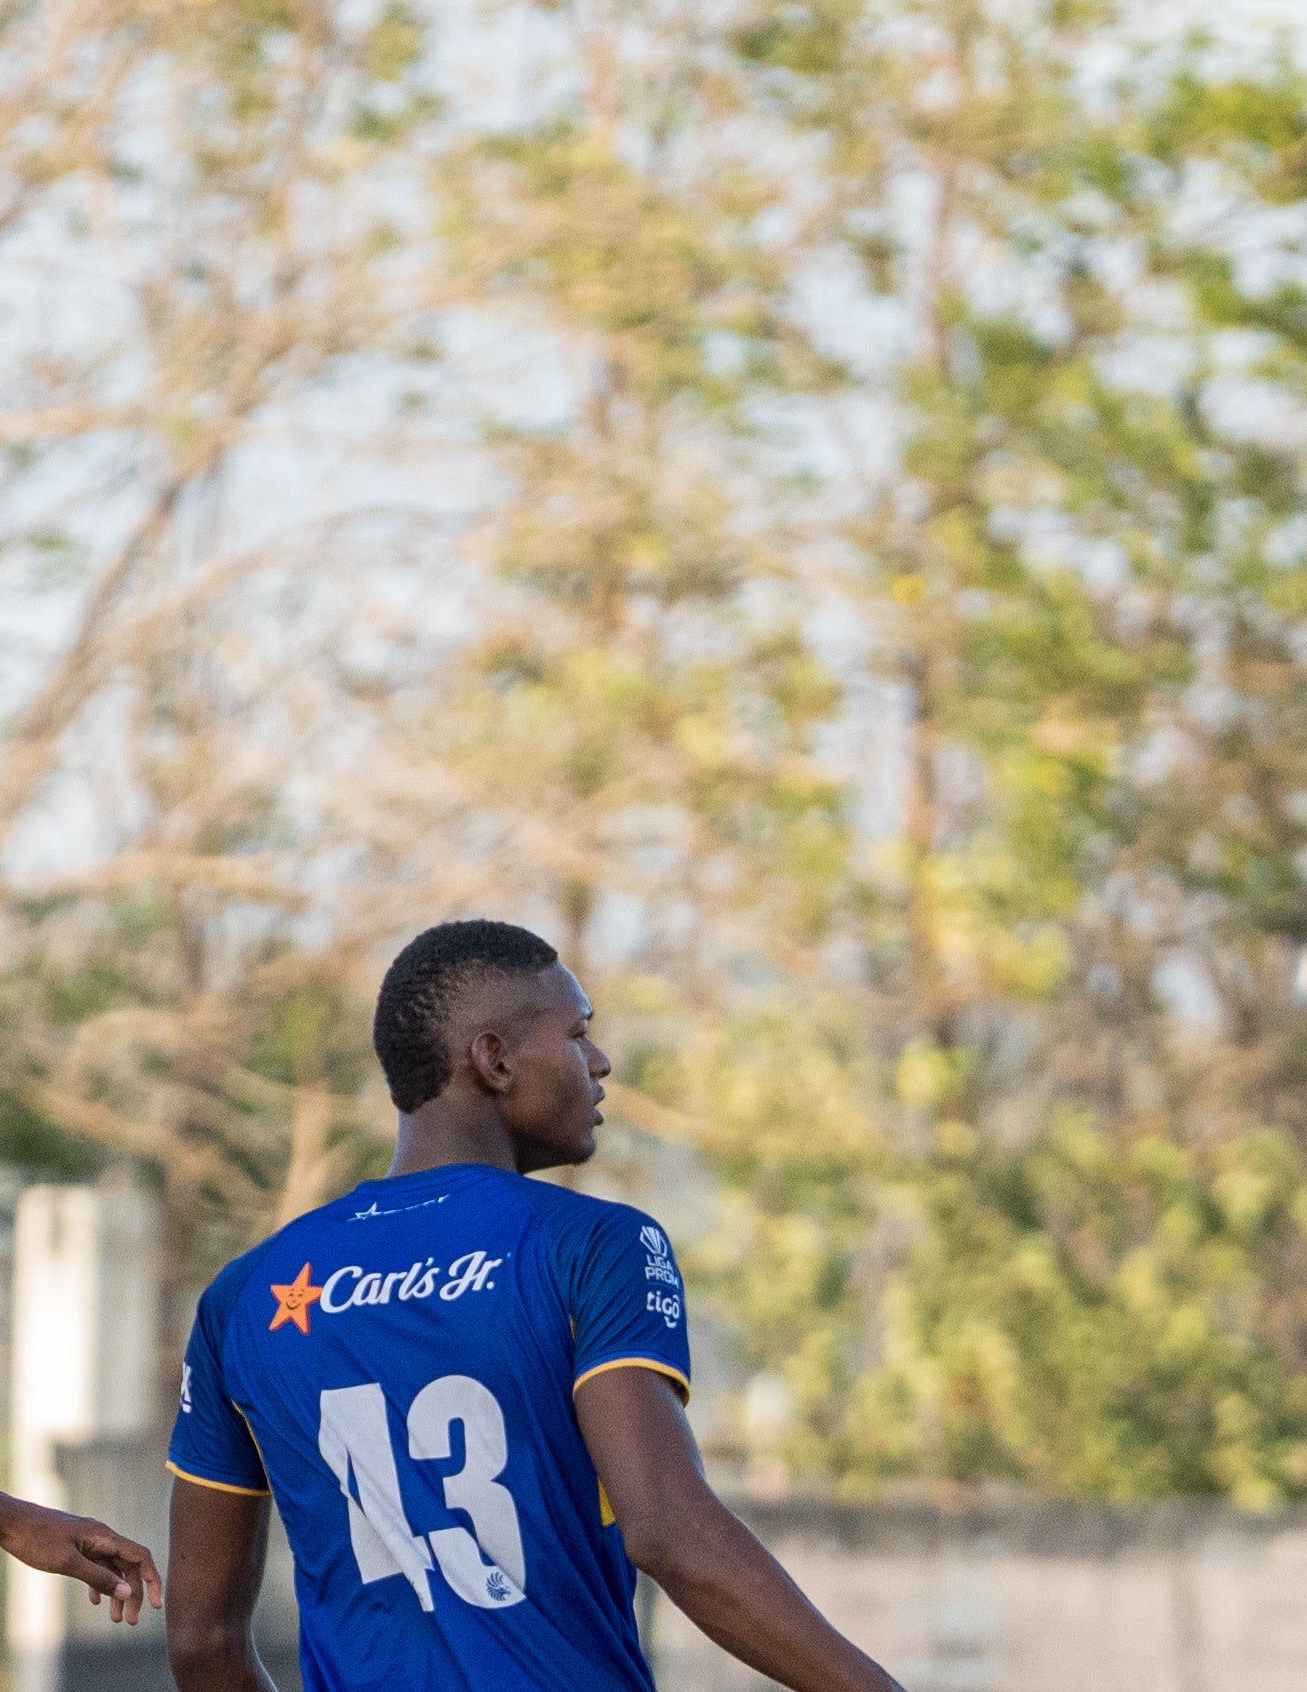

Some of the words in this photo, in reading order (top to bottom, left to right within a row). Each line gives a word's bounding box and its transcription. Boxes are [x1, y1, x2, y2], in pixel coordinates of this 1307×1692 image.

[320, 1257, 441, 1313] Carl's
[439, 1250, 503, 1300] Jr.
[646, 1253, 675, 1275] LIGA
[318, 1374, 527, 1612] 43
